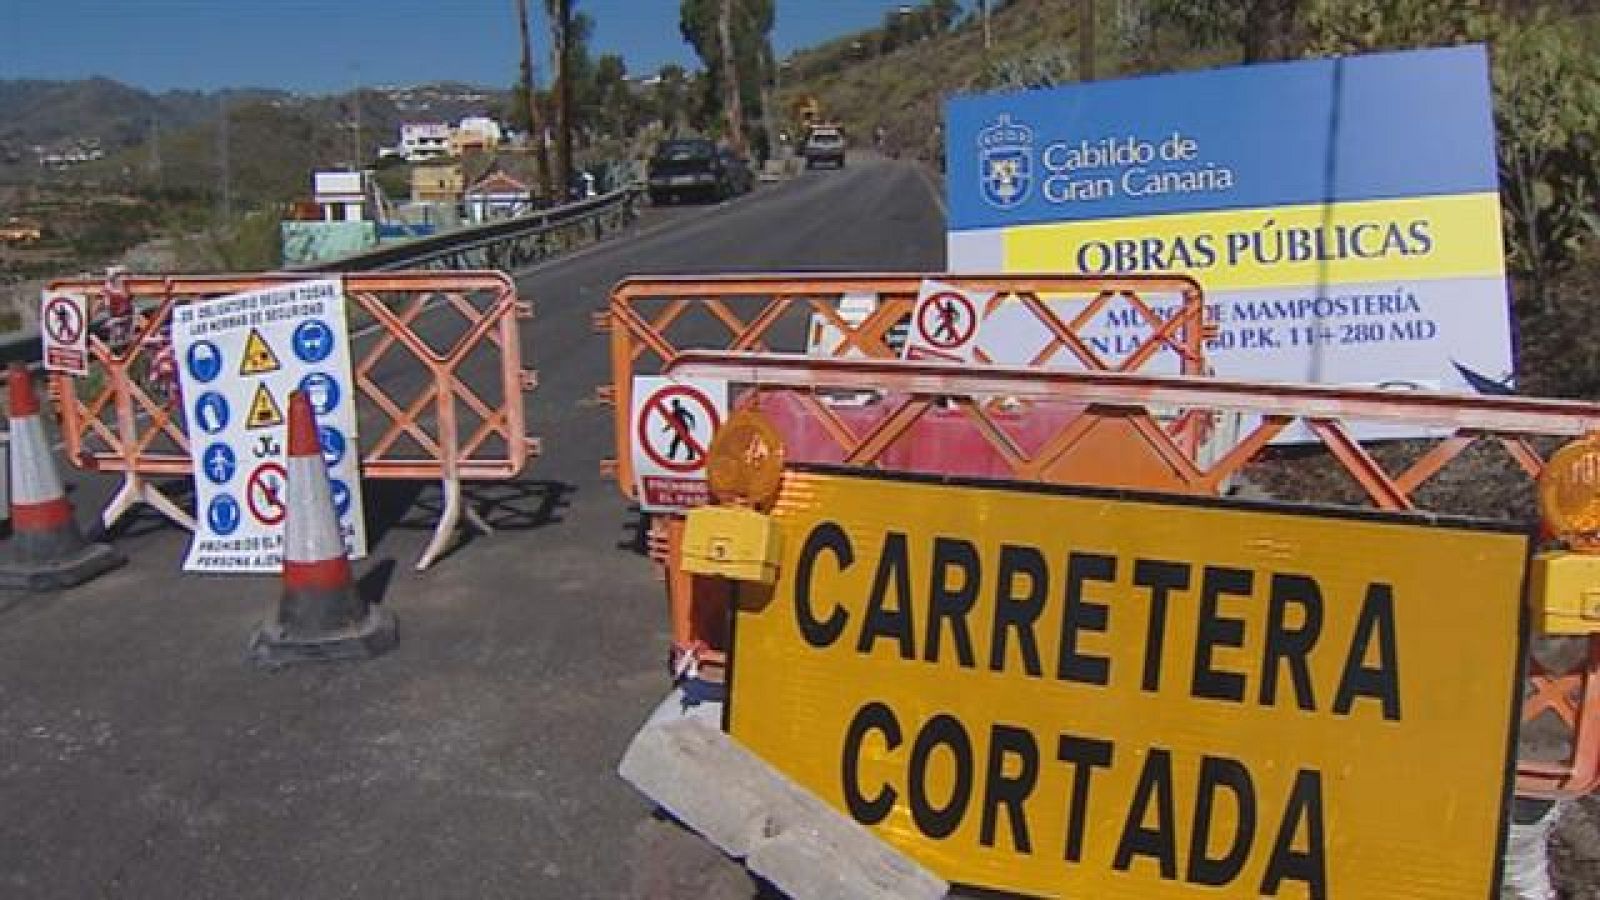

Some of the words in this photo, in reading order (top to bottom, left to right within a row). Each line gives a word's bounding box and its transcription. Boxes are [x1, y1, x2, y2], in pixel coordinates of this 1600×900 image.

[1043, 135, 1155, 171] Cabildo
[1159, 131, 1199, 161] de
[1043, 174, 1114, 202] Gran
[1121, 162, 1234, 196] Canaria
[1077, 233, 1216, 275] OBRAS
[1226, 219, 1433, 266] PÚBLICAS
[1233, 287, 1421, 321] MAMPOSTERÍA
[1389, 319, 1436, 341] MD
[794, 521, 1402, 722] CARRETERA
[841, 701, 1327, 900] CORTADA
